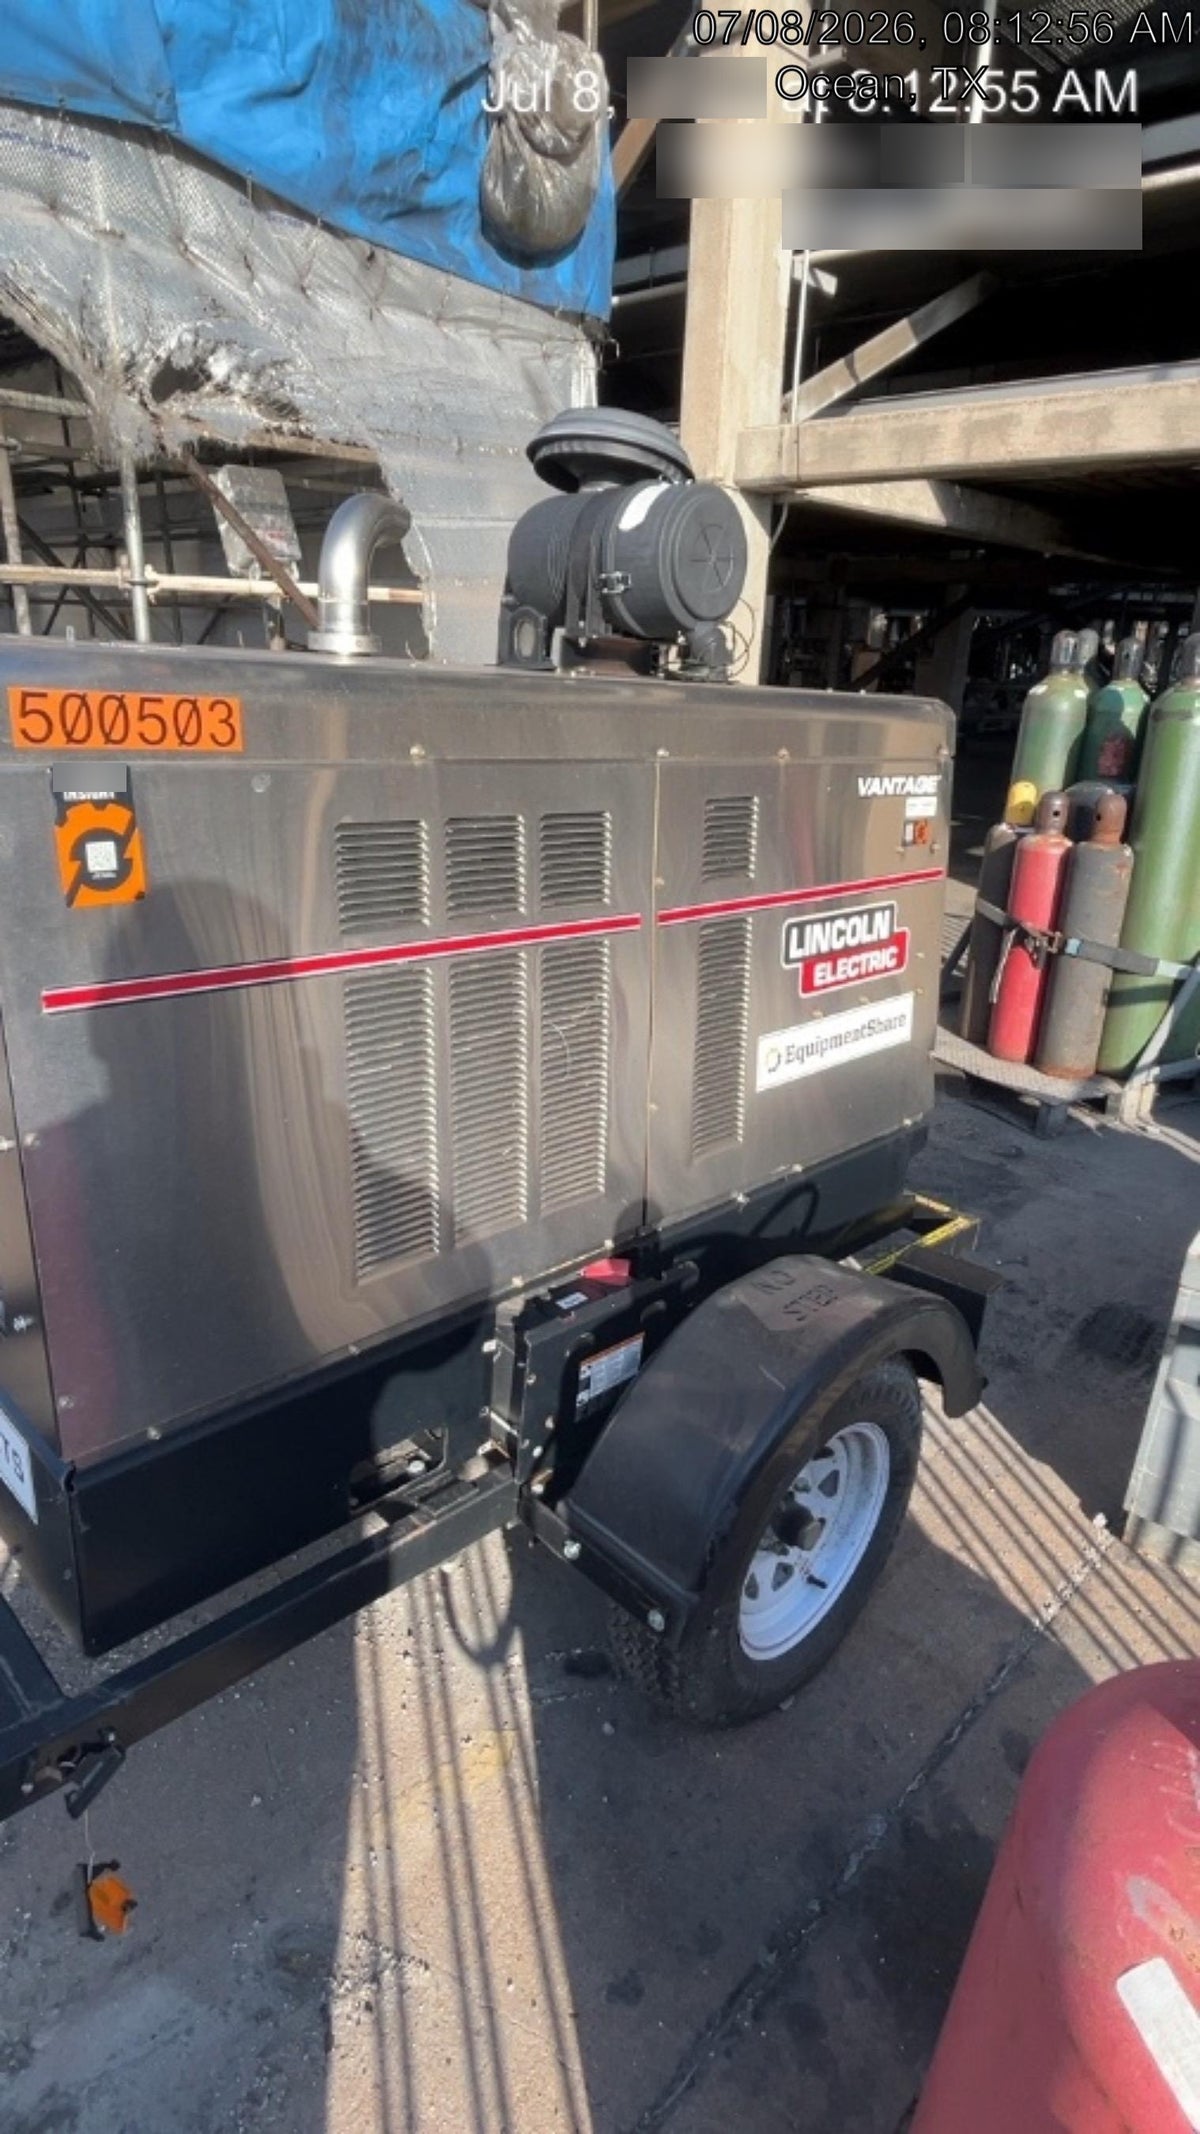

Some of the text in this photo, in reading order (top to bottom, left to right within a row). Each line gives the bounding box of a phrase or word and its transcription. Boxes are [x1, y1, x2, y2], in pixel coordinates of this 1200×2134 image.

[18, 690, 237, 747] 500503
[857, 775, 940, 798] VANTAGE
[788, 909, 891, 959] LINCOLN
[812, 945, 899, 988] ELECTRIC
[784, 1013, 907, 1065] EquipmentShare
